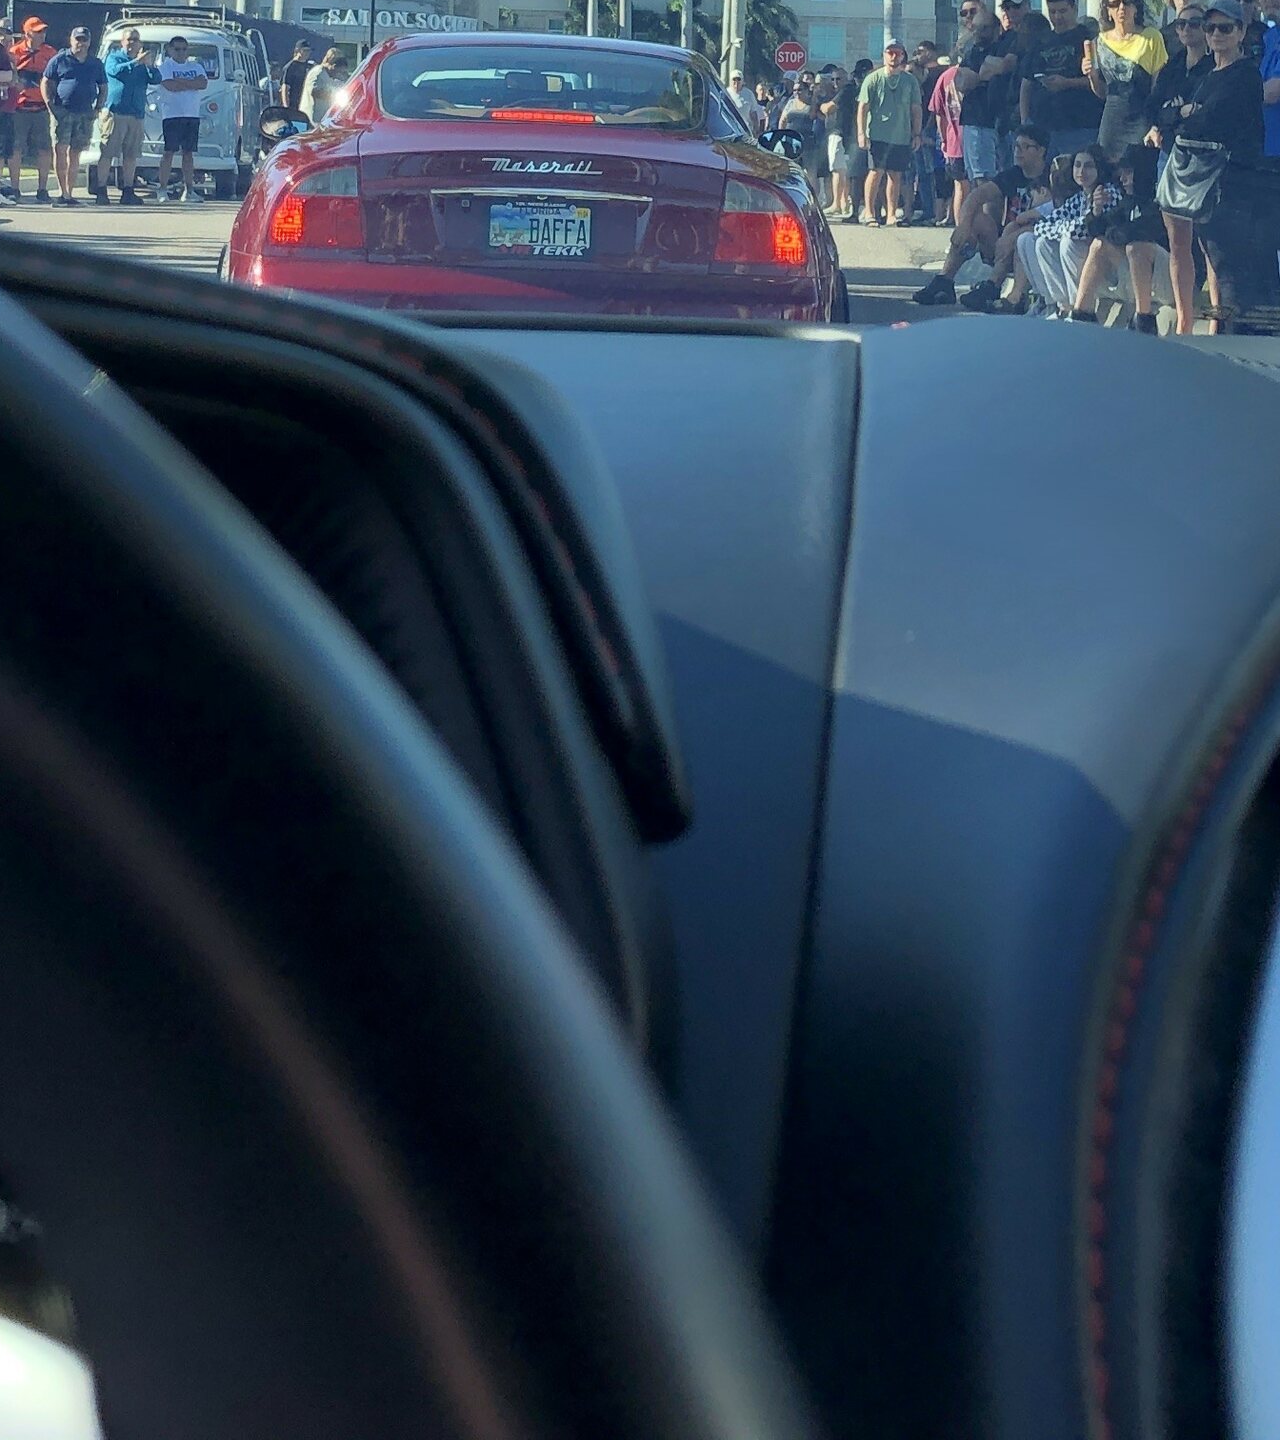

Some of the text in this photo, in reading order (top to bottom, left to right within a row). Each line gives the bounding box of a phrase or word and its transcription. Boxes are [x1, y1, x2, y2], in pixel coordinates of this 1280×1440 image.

[328, 9, 410, 27] SALON
[777, 51, 805, 63] STOP
[482, 158, 602, 174] Maserati
[519, 208, 562, 216] FLORIDA
[529, 219, 587, 244] BAFFA
